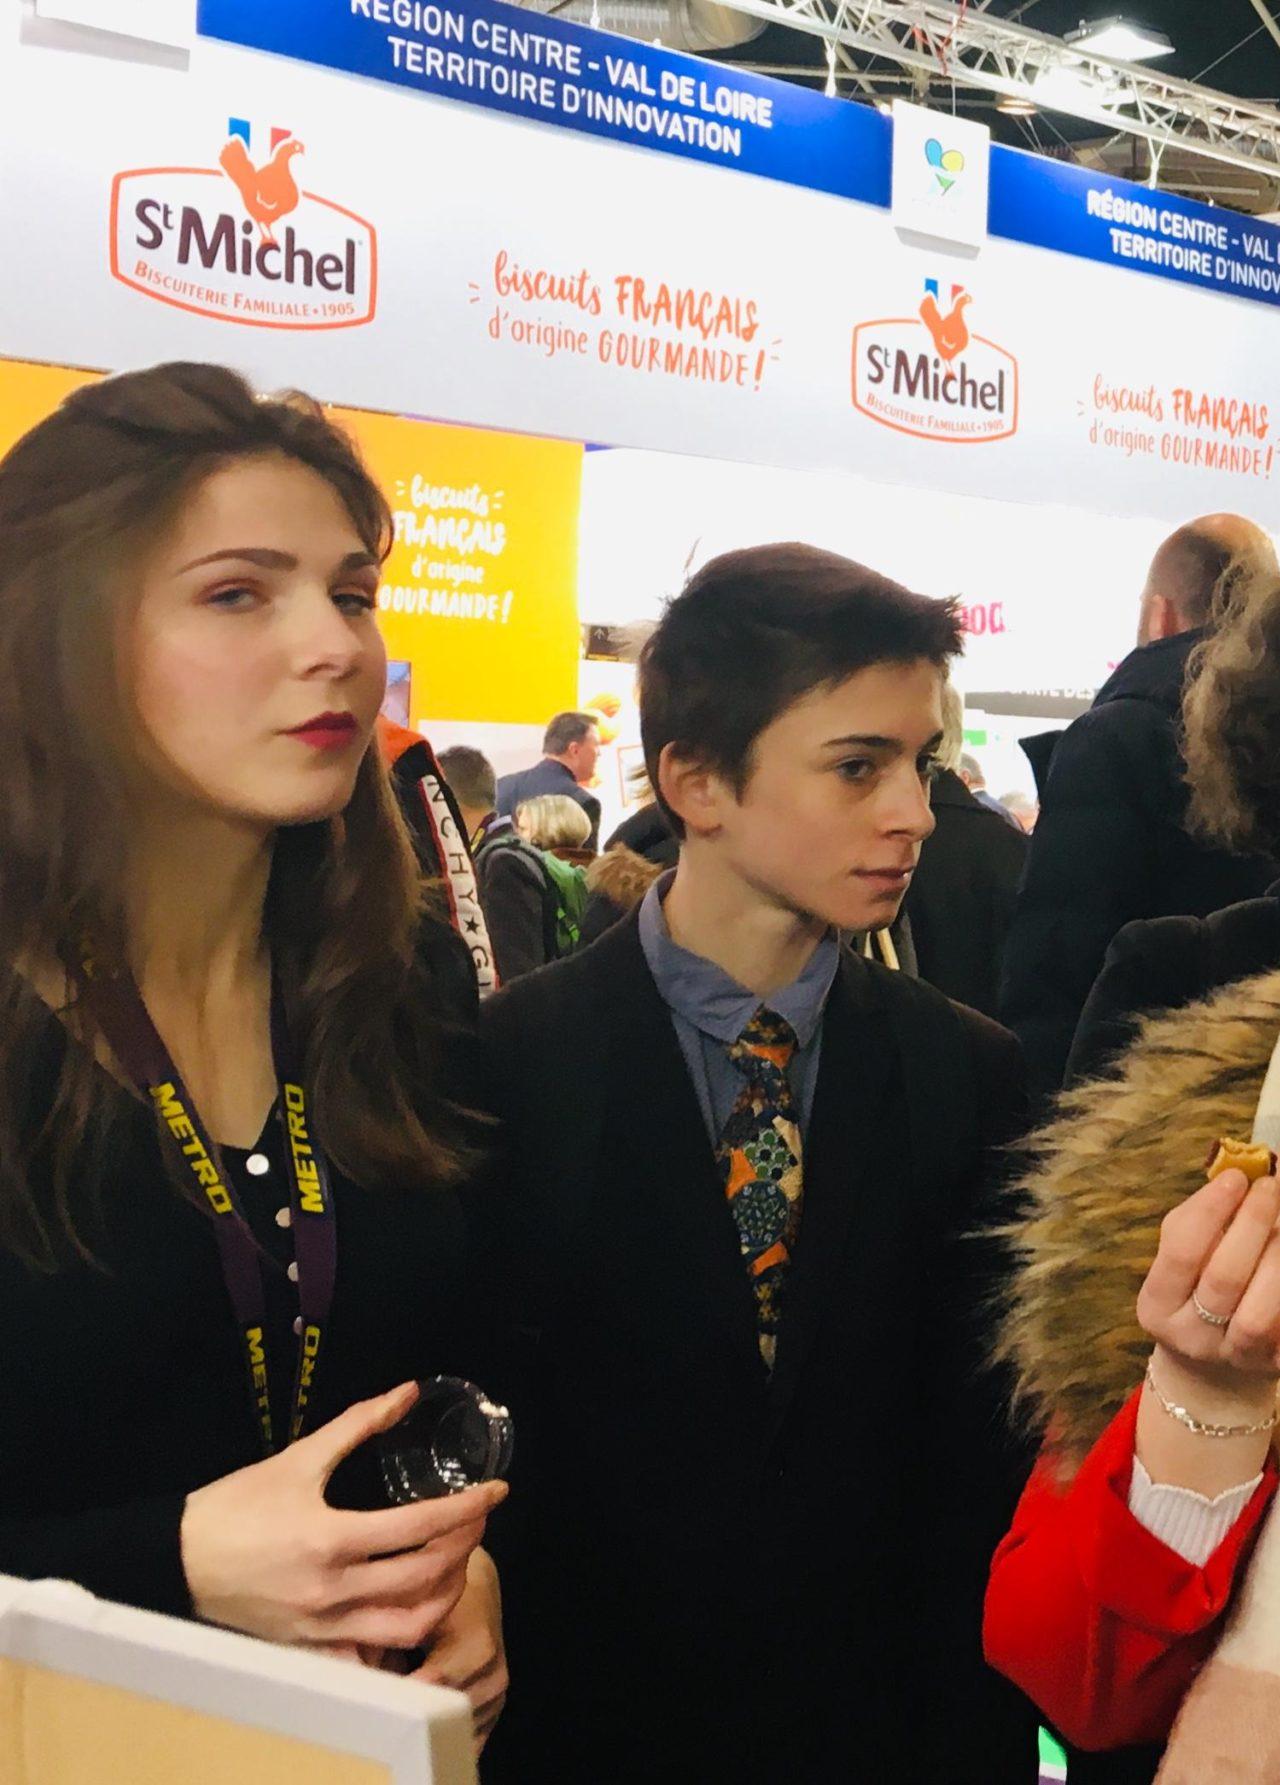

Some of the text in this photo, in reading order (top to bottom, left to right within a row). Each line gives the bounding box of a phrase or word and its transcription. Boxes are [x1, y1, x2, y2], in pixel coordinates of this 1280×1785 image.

[387, 36, 741, 156] TERRITOIRE D'INNOVATION
[472, 19, 581, 76] CENTRE
[605, 55, 656, 97] VAL
[661, 71, 696, 107] DE
[701, 82, 773, 128] LOIRE
[135, 198, 355, 295] St Michel
[1087, 189, 1157, 231] RÉGION
[1160, 210, 1228, 250] CENTRE
[1242, 233, 1274, 263] VAL
[1109, 228, 1213, 277] TERRITOIRE
[322, 302, 355, 317] 1905
[488, 305, 589, 357] d'origine
[493, 250, 760, 342] biscuits FRANÇAIS
[867, 344, 1004, 413] St Michel
[1094, 373, 1270, 440] biscuits FRANÇAIS
[1089, 417, 1155, 457] d'origine
[411, 473, 489, 516] biscuits
[149, 1082, 233, 1213] METRO
[285, 1083, 323, 1213] METRO
